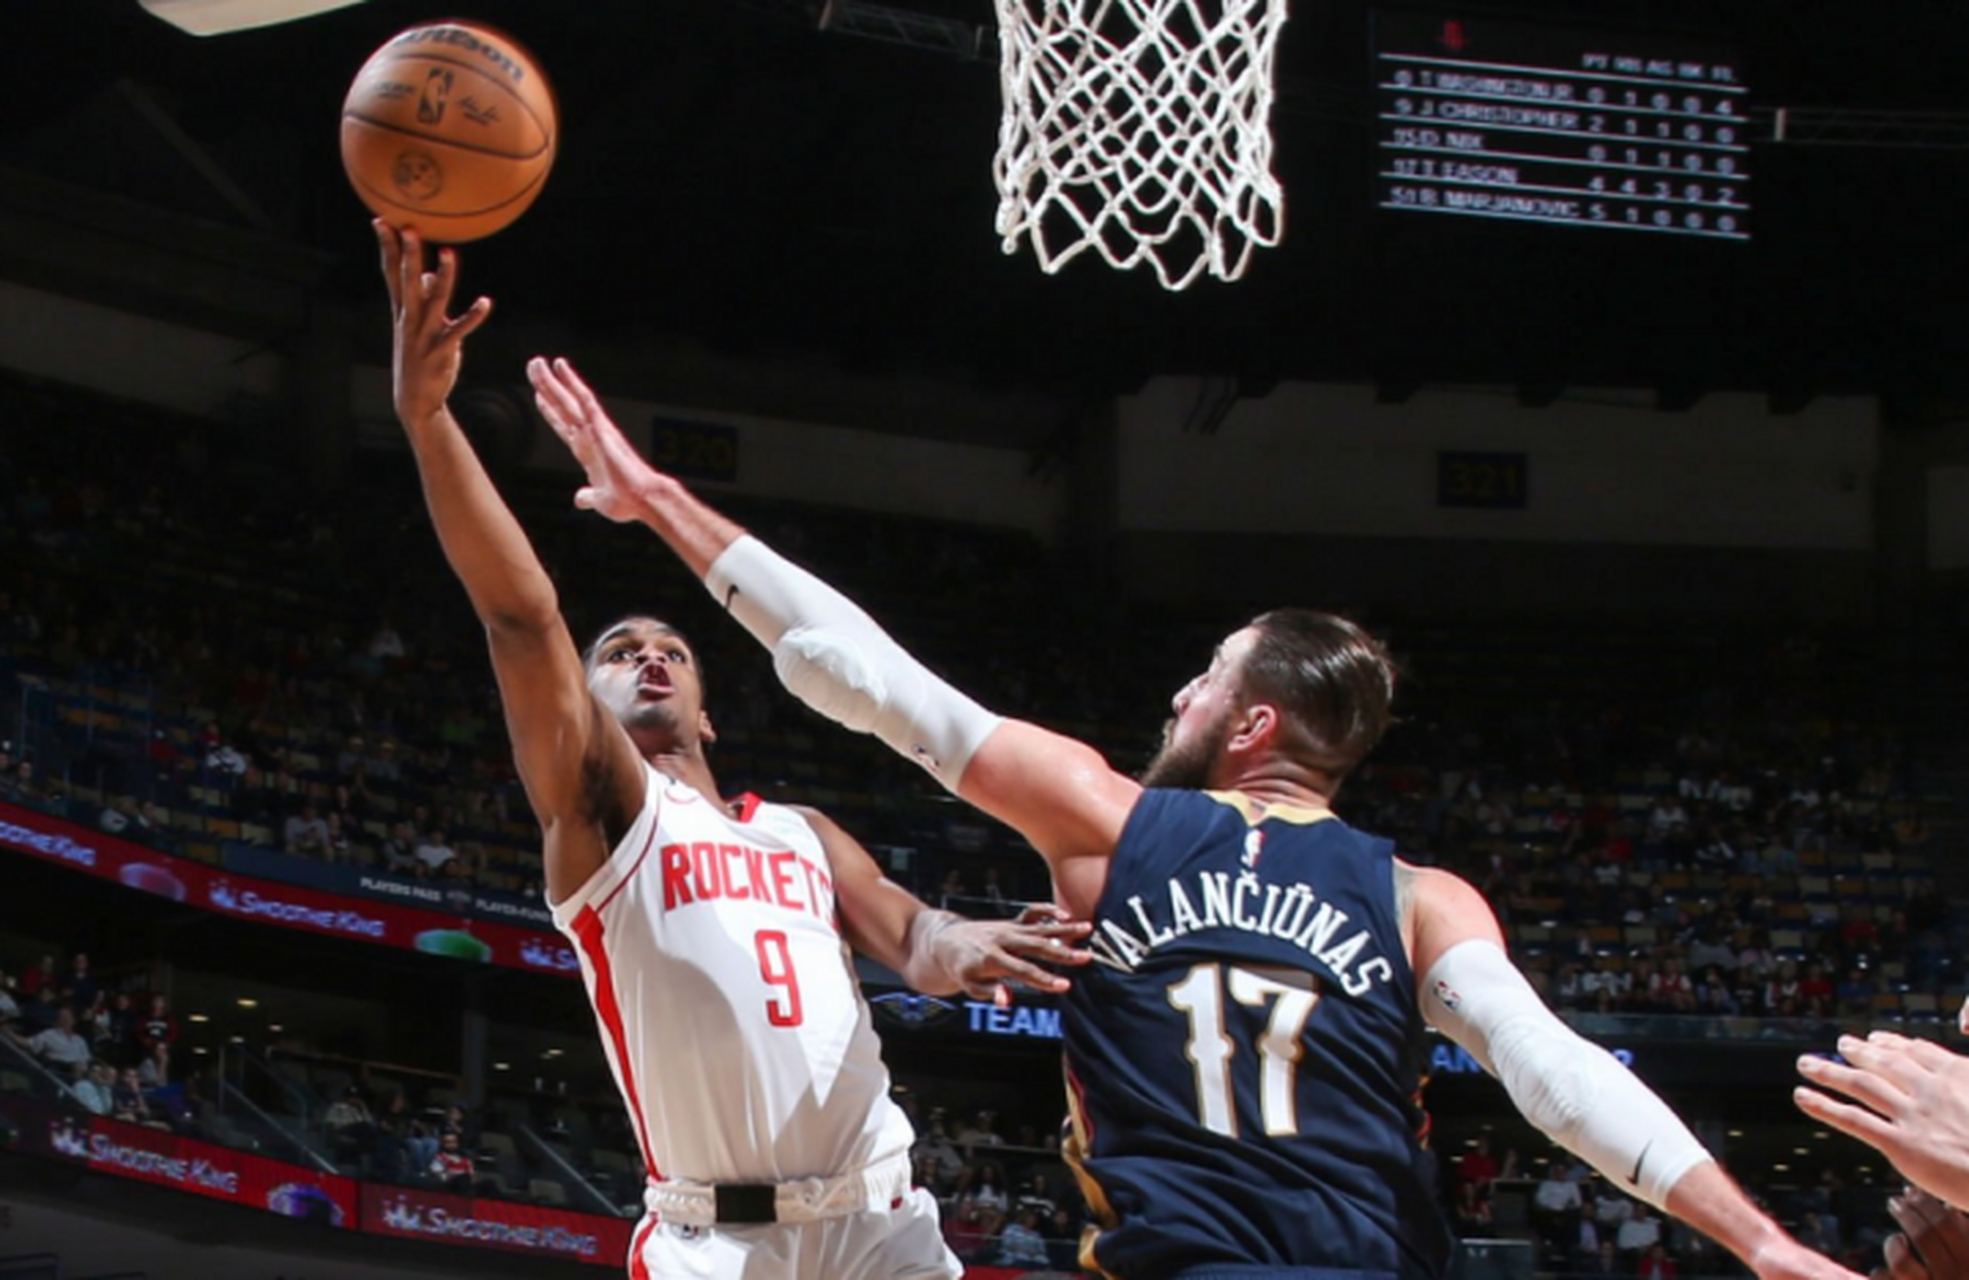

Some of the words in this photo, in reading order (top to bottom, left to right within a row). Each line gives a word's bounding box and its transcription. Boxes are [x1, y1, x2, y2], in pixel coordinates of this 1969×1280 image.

[1438, 102, 1579, 127] CHRISTOPHER
[1715, 100, 1732, 115] 4
[1442, 162, 1518, 183] EASON
[1588, 176, 1605, 191] 4
[1620, 179, 1637, 193] 4
[754, 930, 803, 1028] 9
[963, 1001, 1065, 1038] TEAM
[1166, 962, 1320, 1139] 17
[90, 1133, 188, 1182] SMOOTHIE
[427, 1207, 540, 1248] SMOOTHIE
